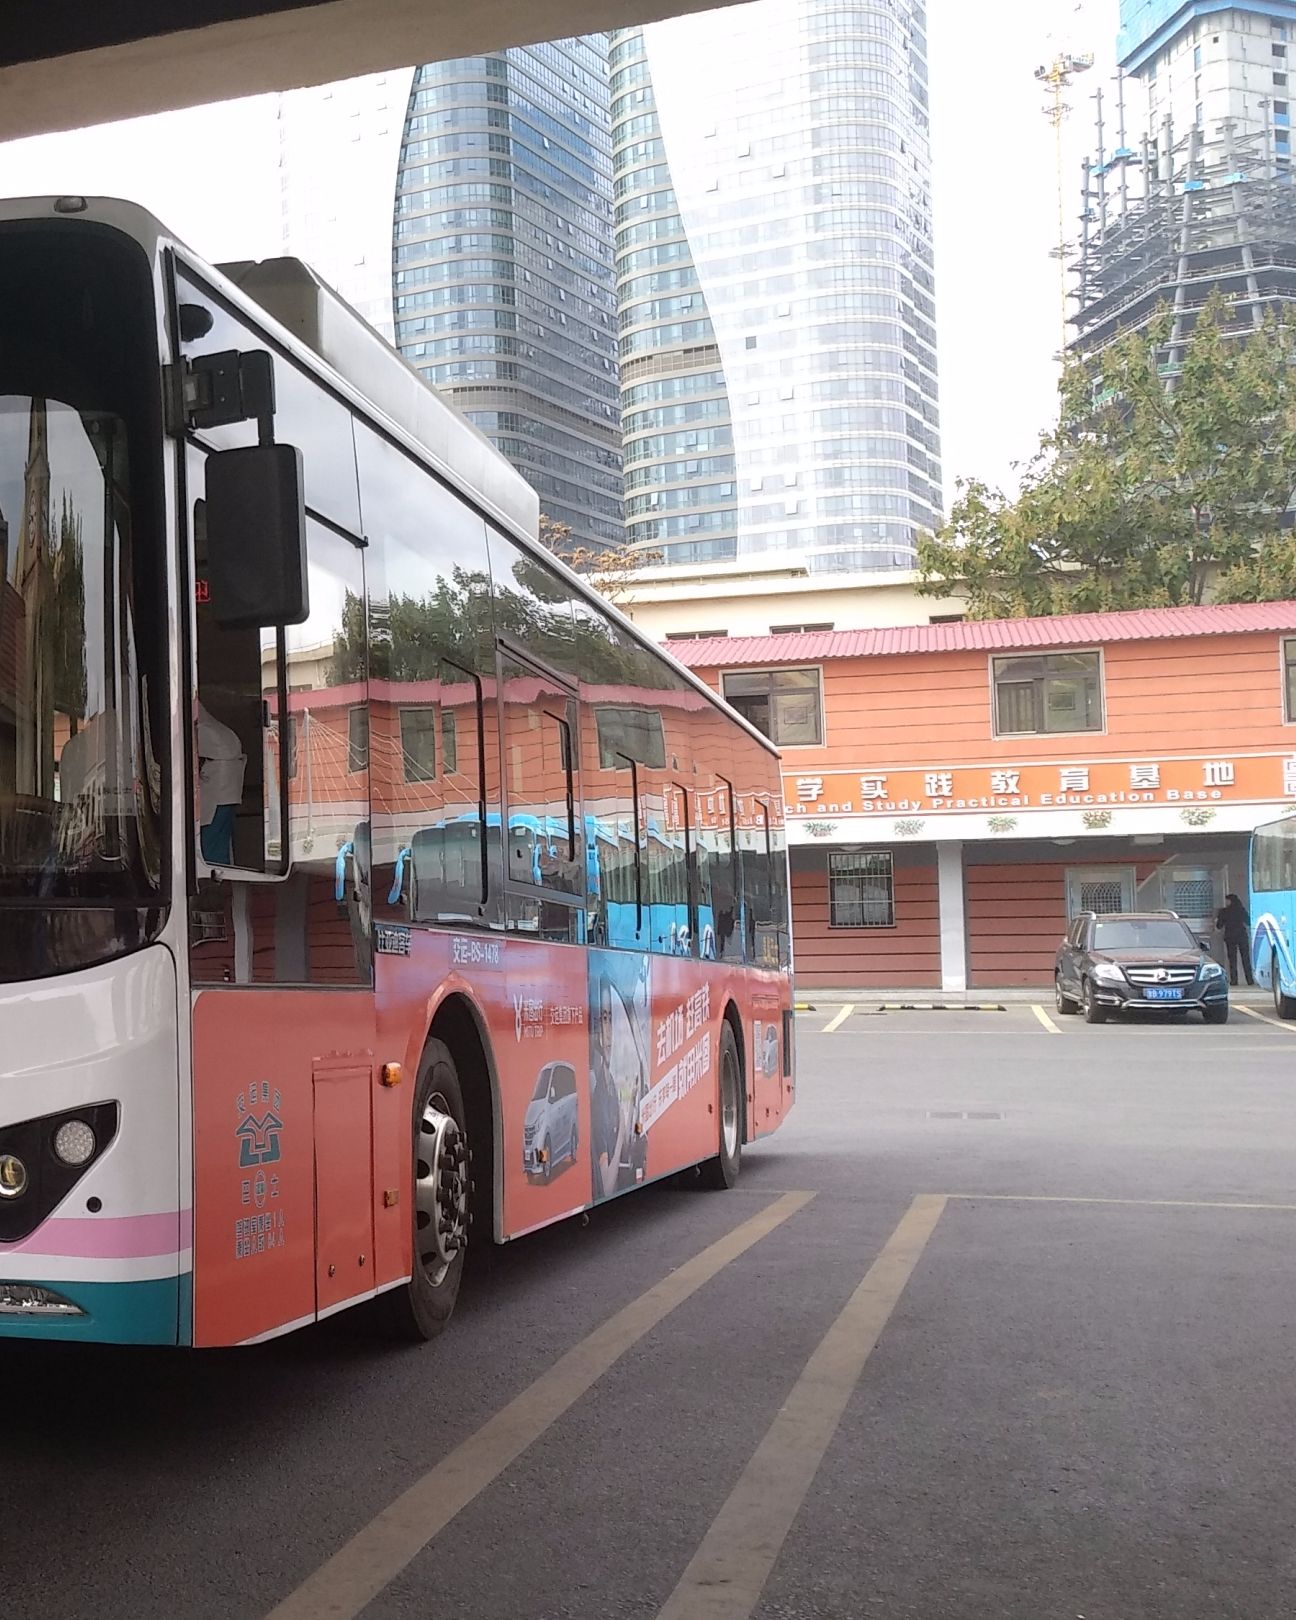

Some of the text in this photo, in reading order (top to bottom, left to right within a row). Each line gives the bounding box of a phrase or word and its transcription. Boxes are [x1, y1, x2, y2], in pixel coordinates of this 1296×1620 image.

[817, 801, 853, 813] and
[863, 799, 922, 812] Study
[933, 794, 1029, 810] Practical
[1040, 790, 1155, 806] Education
[1167, 789, 1223, 801] Base
